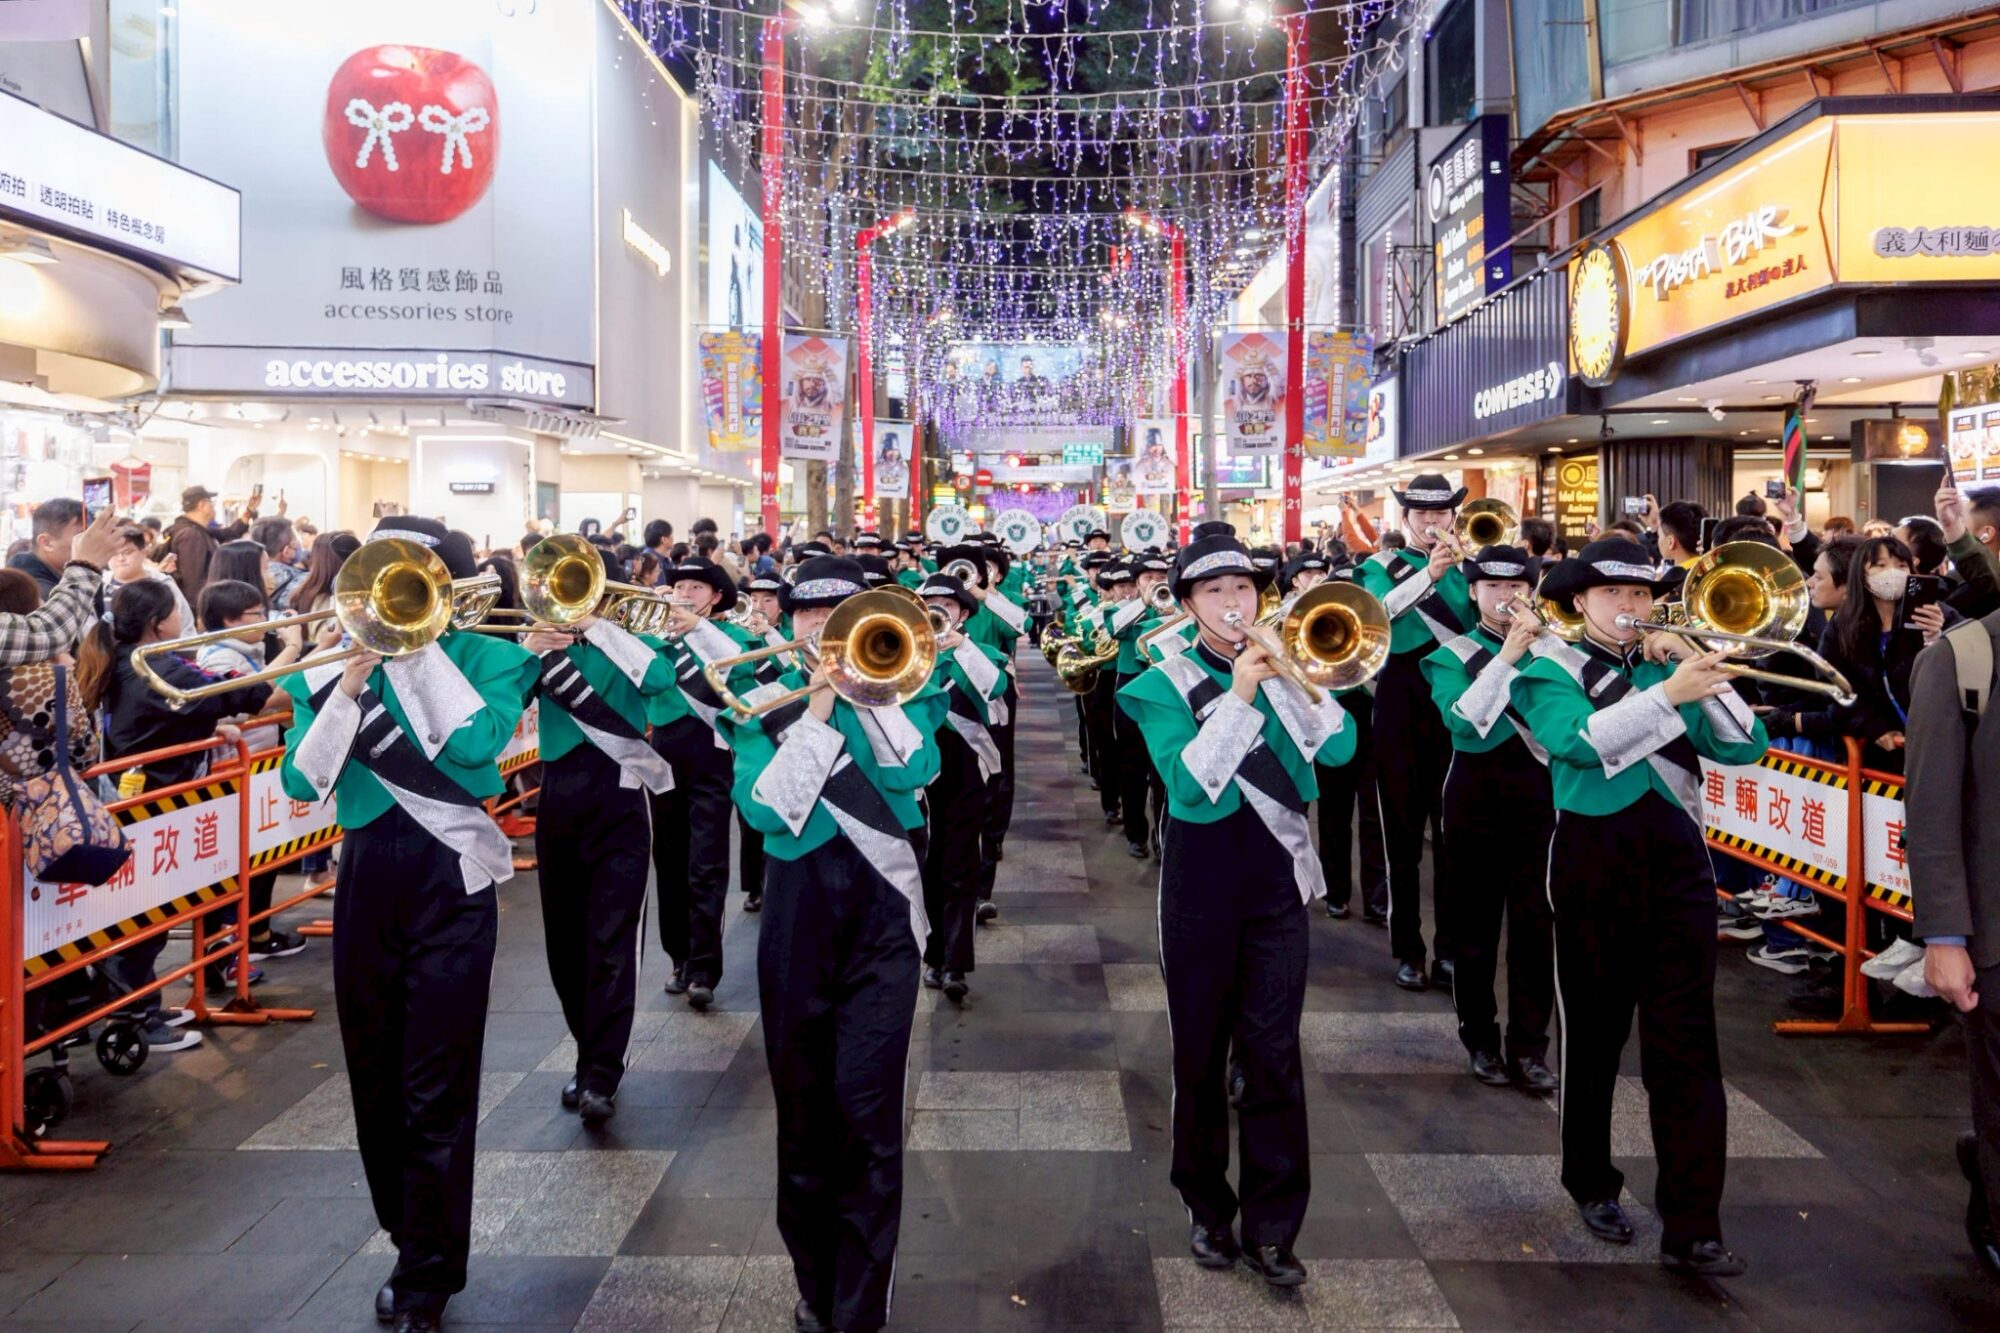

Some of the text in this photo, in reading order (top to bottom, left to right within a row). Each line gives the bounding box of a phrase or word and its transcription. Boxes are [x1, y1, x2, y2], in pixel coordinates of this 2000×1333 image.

[1651, 235, 1711, 301] PASTA
[1719, 205, 1796, 265] BAR
[340, 266, 503, 294] 風格質感飾品
[325, 302, 513, 324] accessories store
[265, 354, 566, 398] accessories store
[1474, 369, 1545, 420] CONVERSE
[763, 472, 776, 483] W
[1288, 475, 1301, 487] W
[762, 494, 776, 505] 22
[1287, 498, 1301, 509] 21
[1706, 769, 1826, 847] 車輛改道
